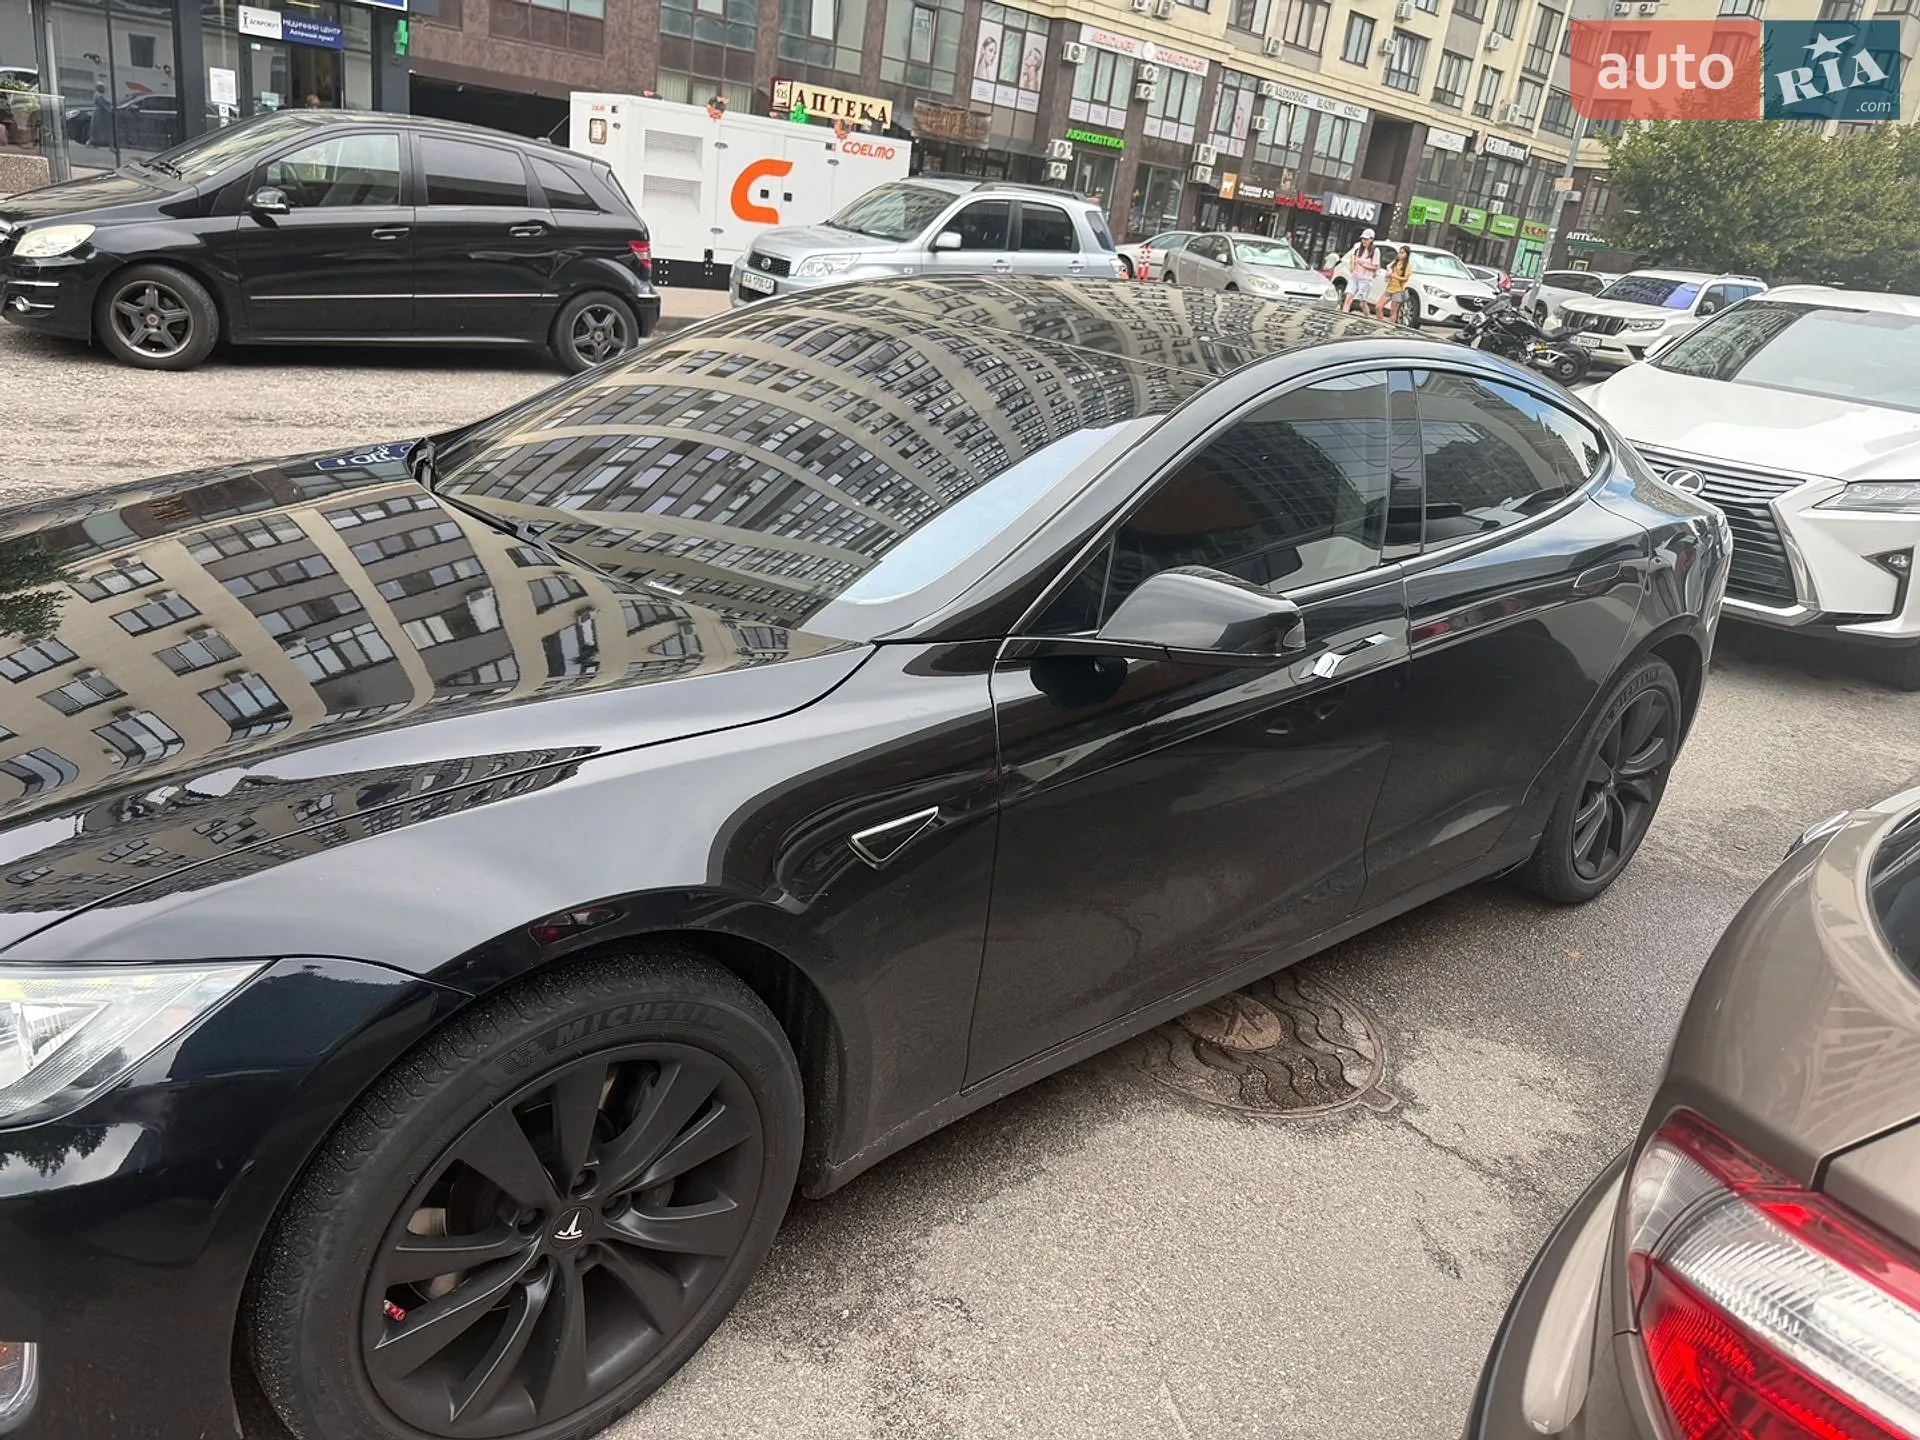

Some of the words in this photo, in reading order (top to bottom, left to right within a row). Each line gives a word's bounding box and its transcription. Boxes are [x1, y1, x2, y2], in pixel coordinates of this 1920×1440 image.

[794, 89, 888, 125] АПТЕКА
[842, 141, 896, 161] COELMO
[1066, 128, 1125, 150] ЛЮКСОПТИКА
[1329, 194, 1376, 221] NOVUS
[555, 1002, 726, 1048] MICHELIN
